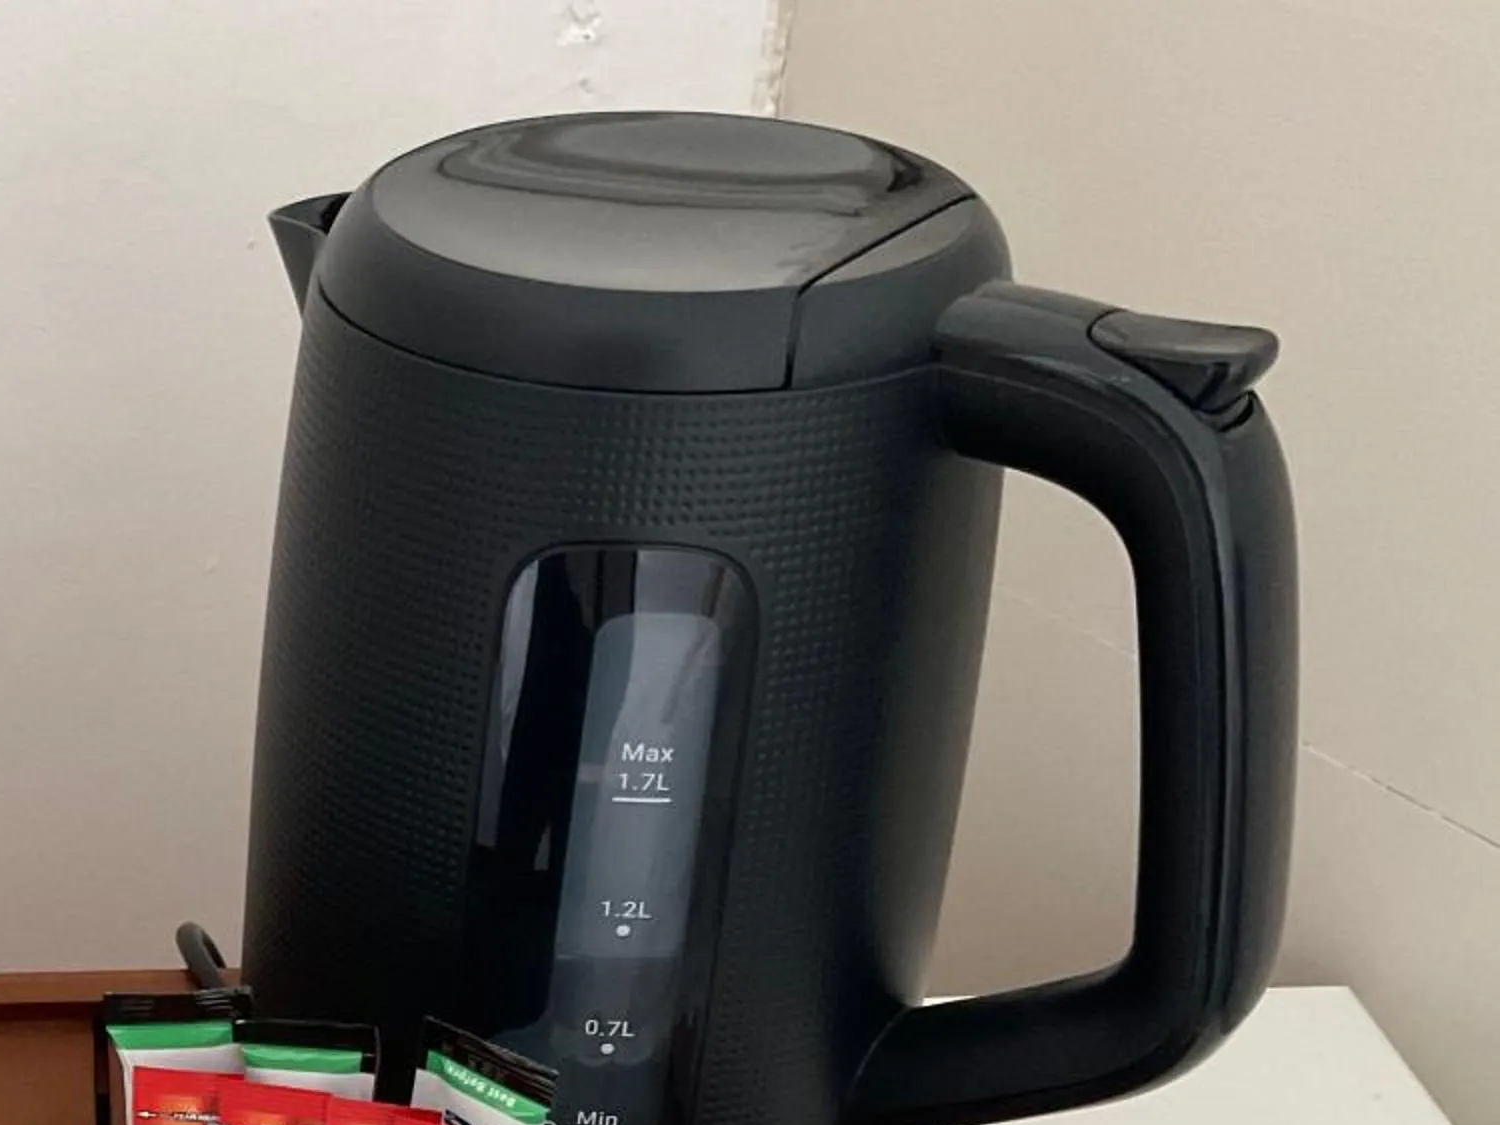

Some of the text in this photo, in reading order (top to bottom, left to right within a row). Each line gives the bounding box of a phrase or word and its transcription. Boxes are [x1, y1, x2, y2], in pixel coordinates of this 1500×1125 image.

[621, 742, 675, 763] Max
[619, 772, 671, 791] 1.7L
[601, 900, 653, 919] 1.2L
[584, 1018, 636, 1038] 0.7L
